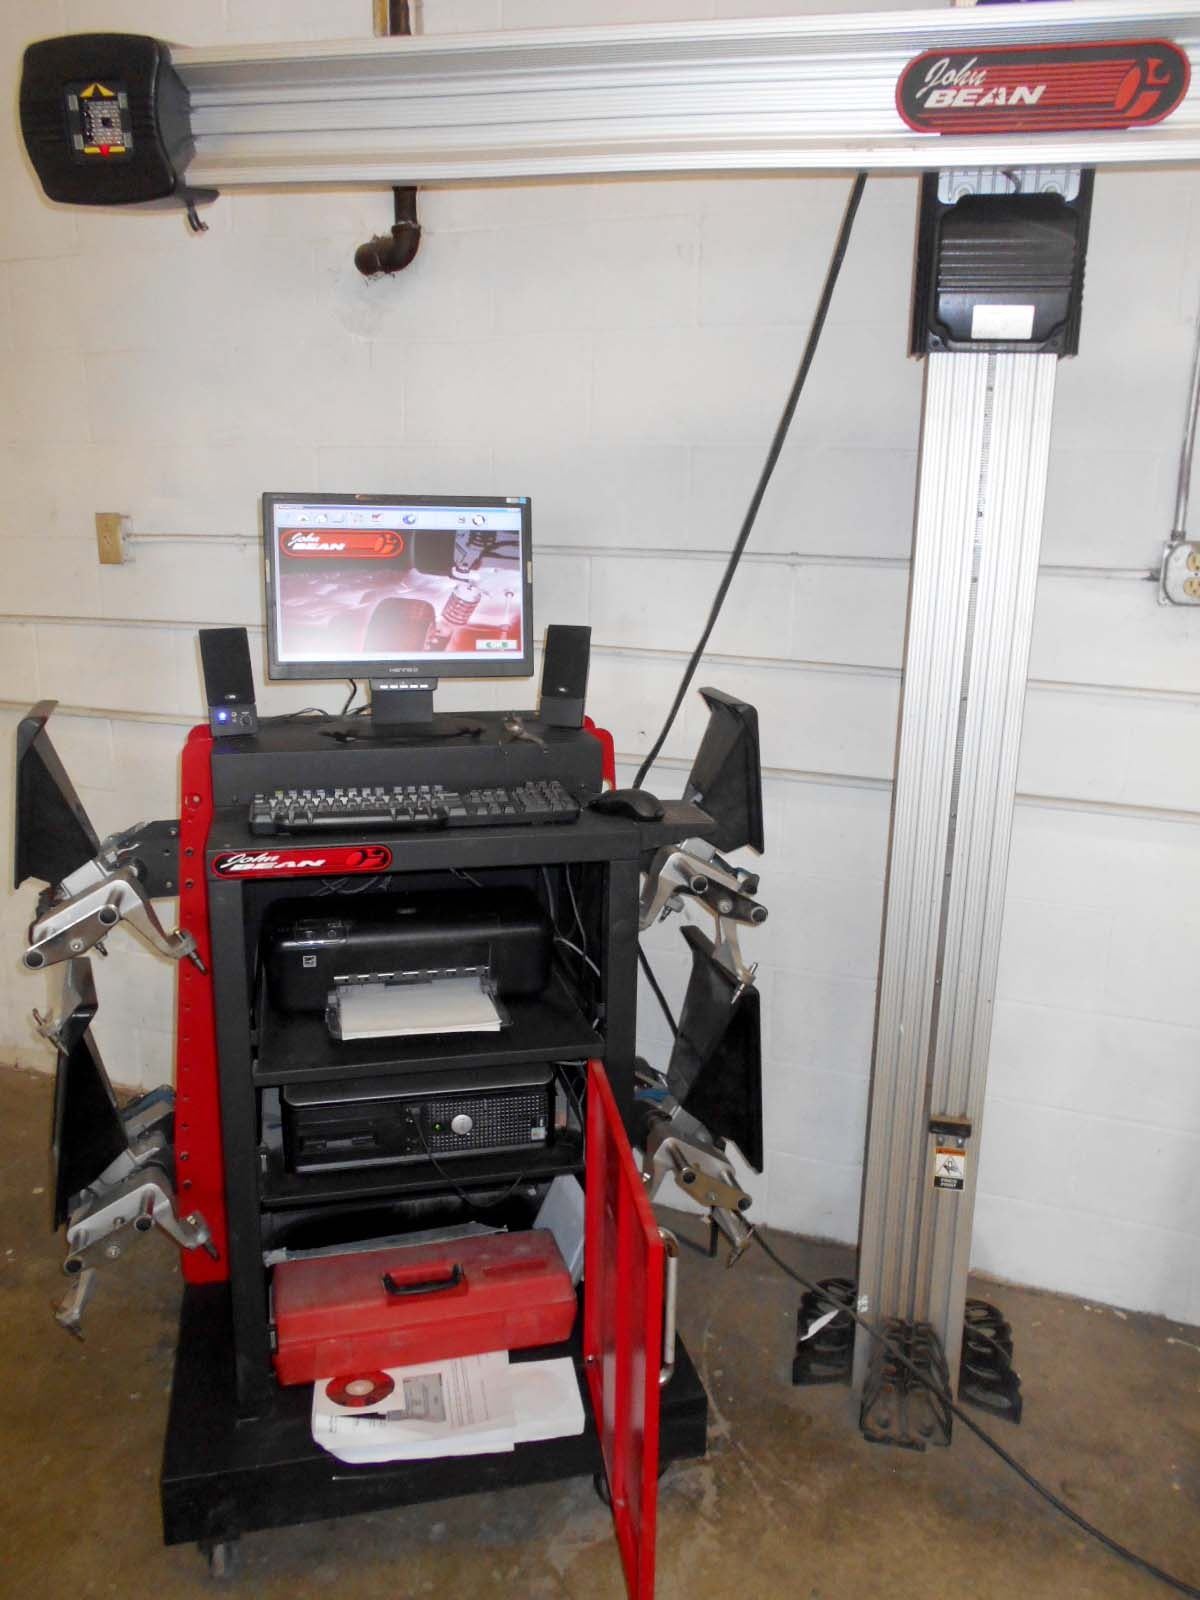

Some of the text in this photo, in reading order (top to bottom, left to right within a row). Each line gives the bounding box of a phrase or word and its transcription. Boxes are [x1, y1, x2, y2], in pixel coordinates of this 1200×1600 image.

[915, 56, 987, 99] John
[923, 85, 1047, 108] BEAN
[220, 852, 280, 869] John
[229, 859, 327, 871] BEAN
